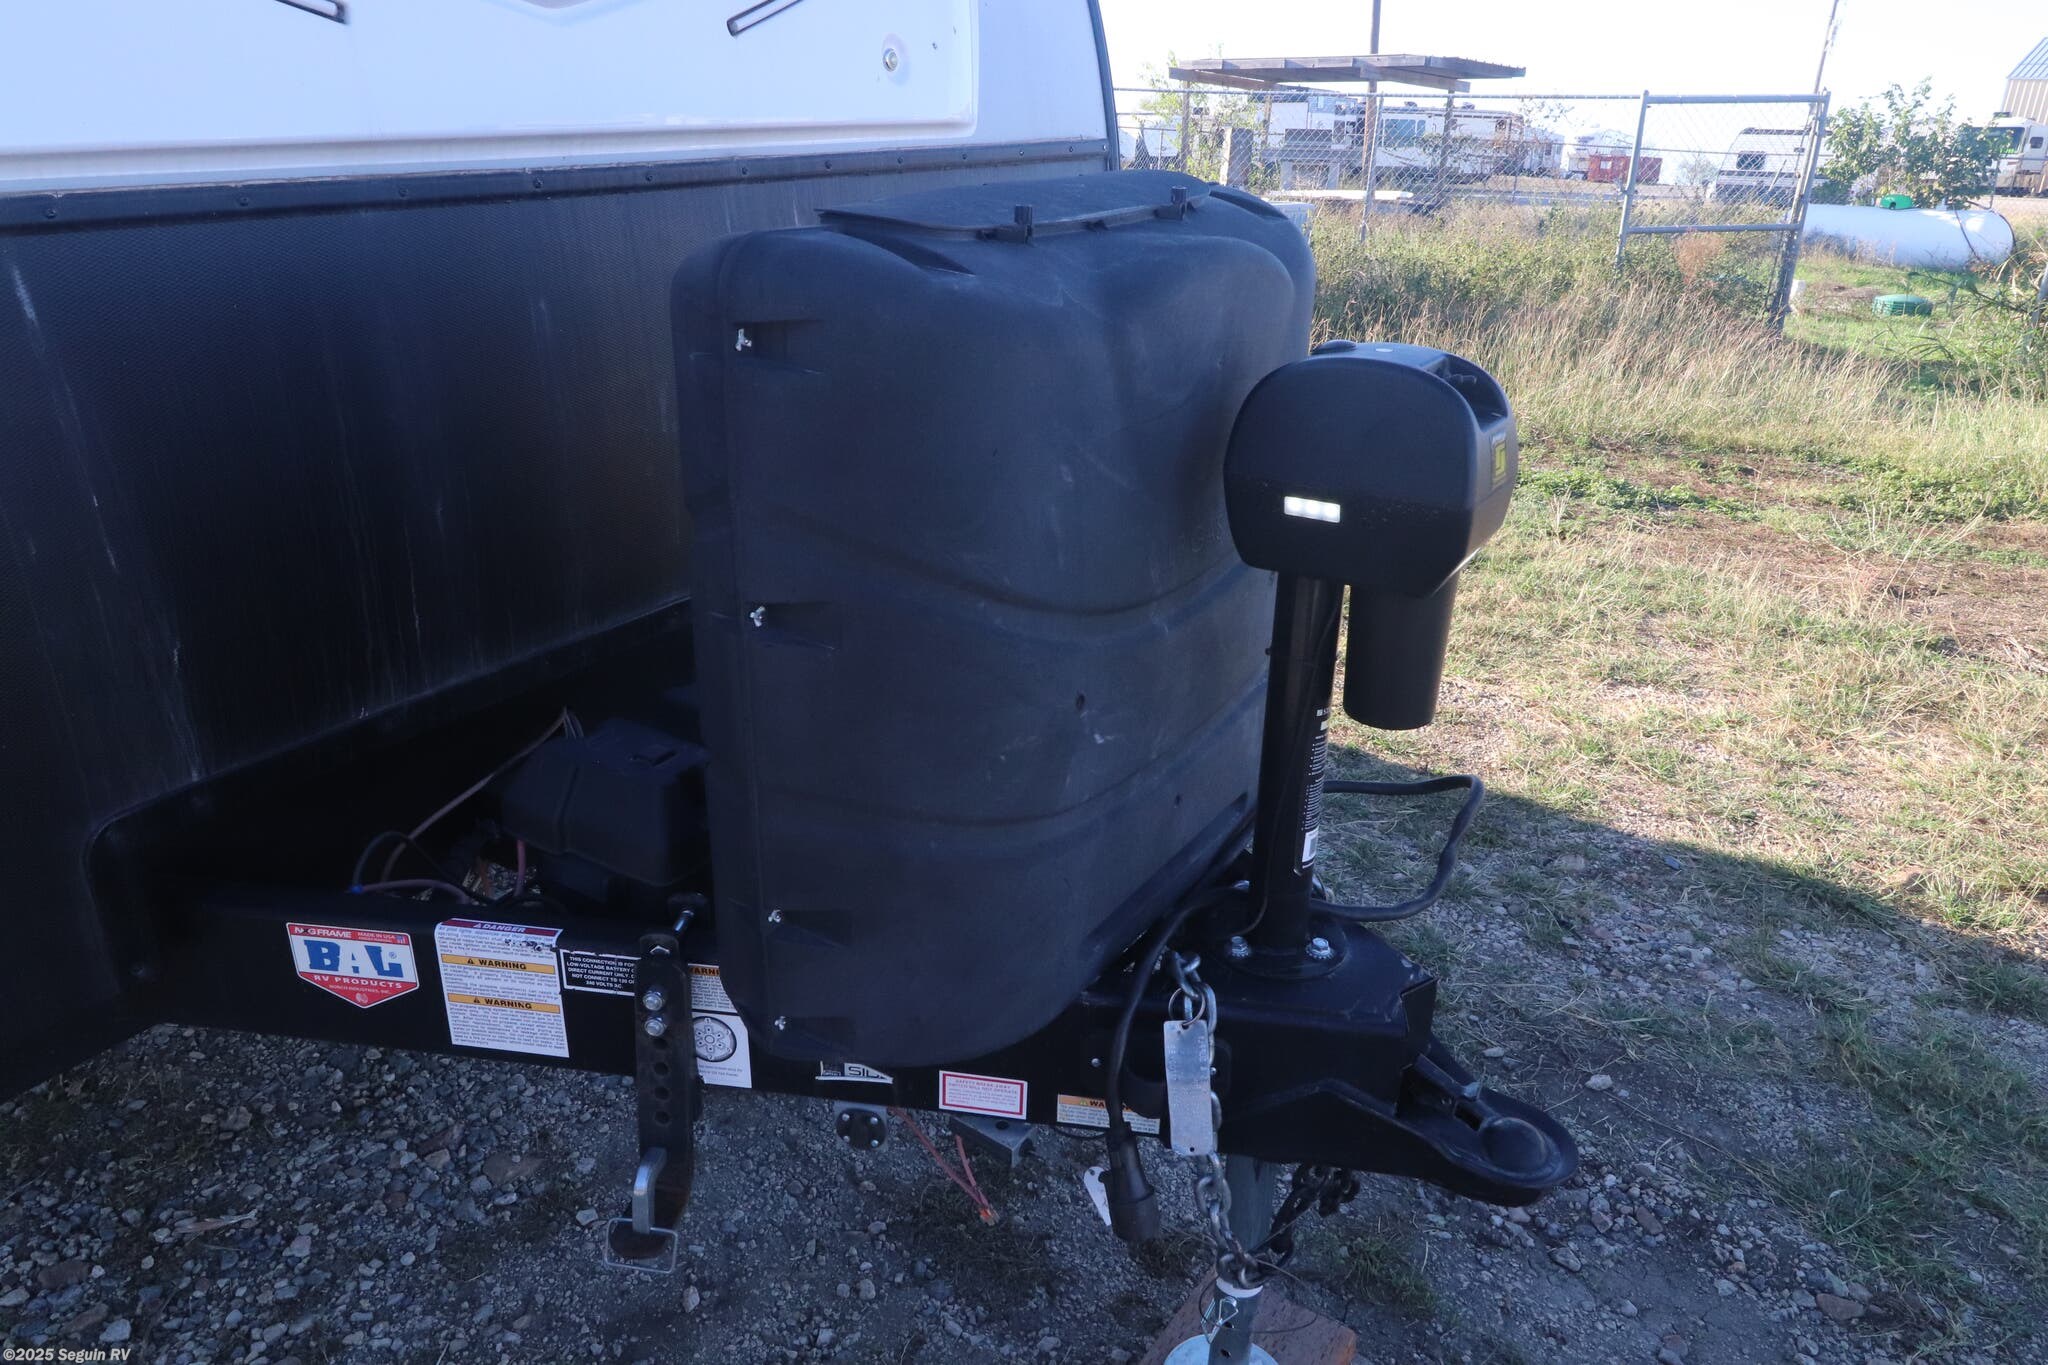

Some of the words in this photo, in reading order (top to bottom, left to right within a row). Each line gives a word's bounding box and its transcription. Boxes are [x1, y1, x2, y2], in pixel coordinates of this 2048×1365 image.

[482, 923, 526, 933] DANGER
[304, 939, 404, 978] BAL
[582, 957, 617, 966] CONNECTION
[479, 960, 526, 970] WARNING
[334, 977, 402, 988] PRODUCTS
[583, 974, 609, 982] CONNECT
[484, 998, 532, 1009] WARNING
